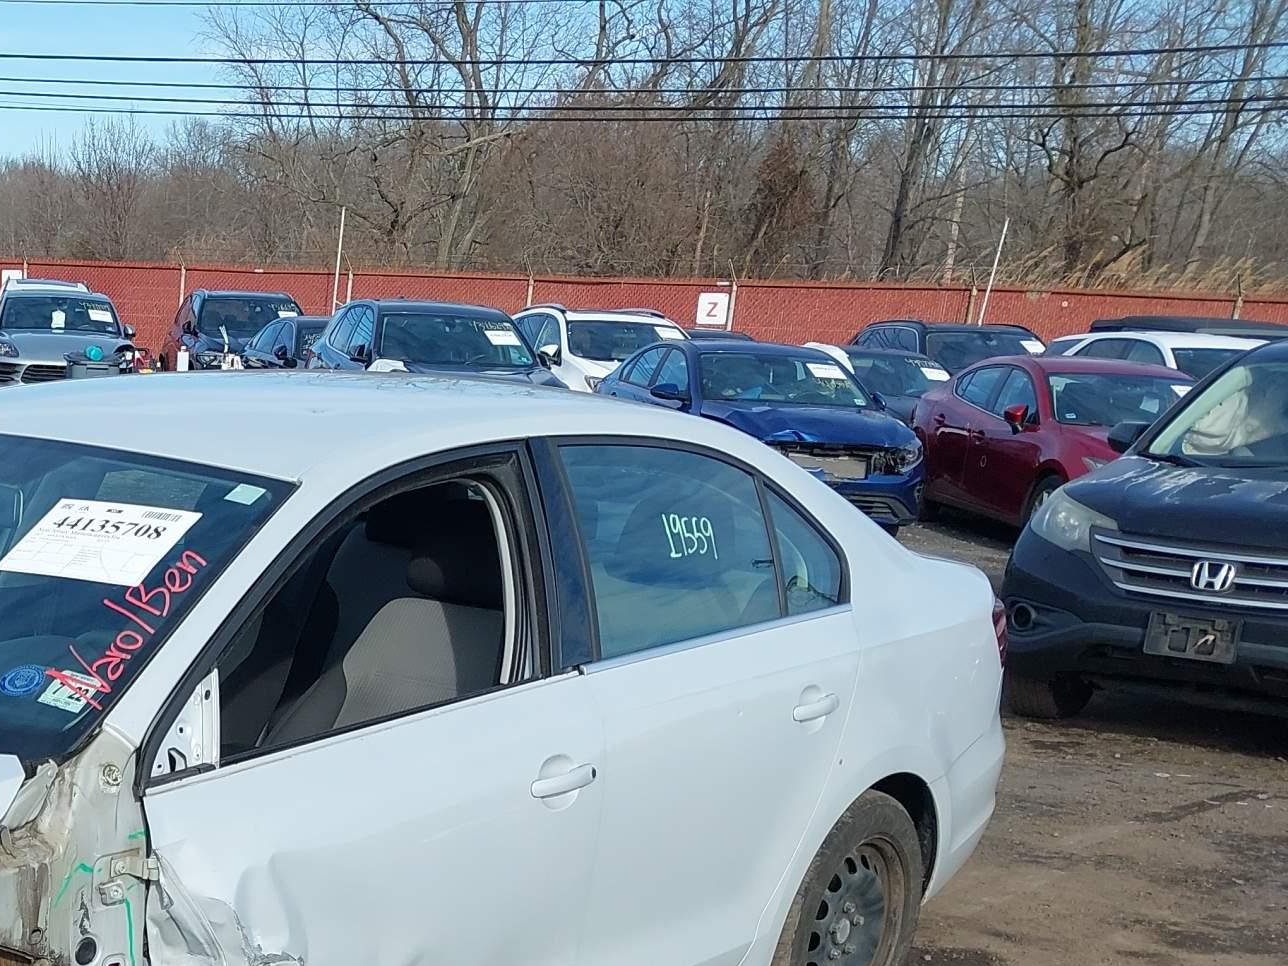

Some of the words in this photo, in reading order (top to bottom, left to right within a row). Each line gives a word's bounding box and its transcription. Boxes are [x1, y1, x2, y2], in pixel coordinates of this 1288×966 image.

[705, 301, 719, 318] Z
[52, 515, 168, 541] 44135708
[661, 514, 719, 560] 19559
